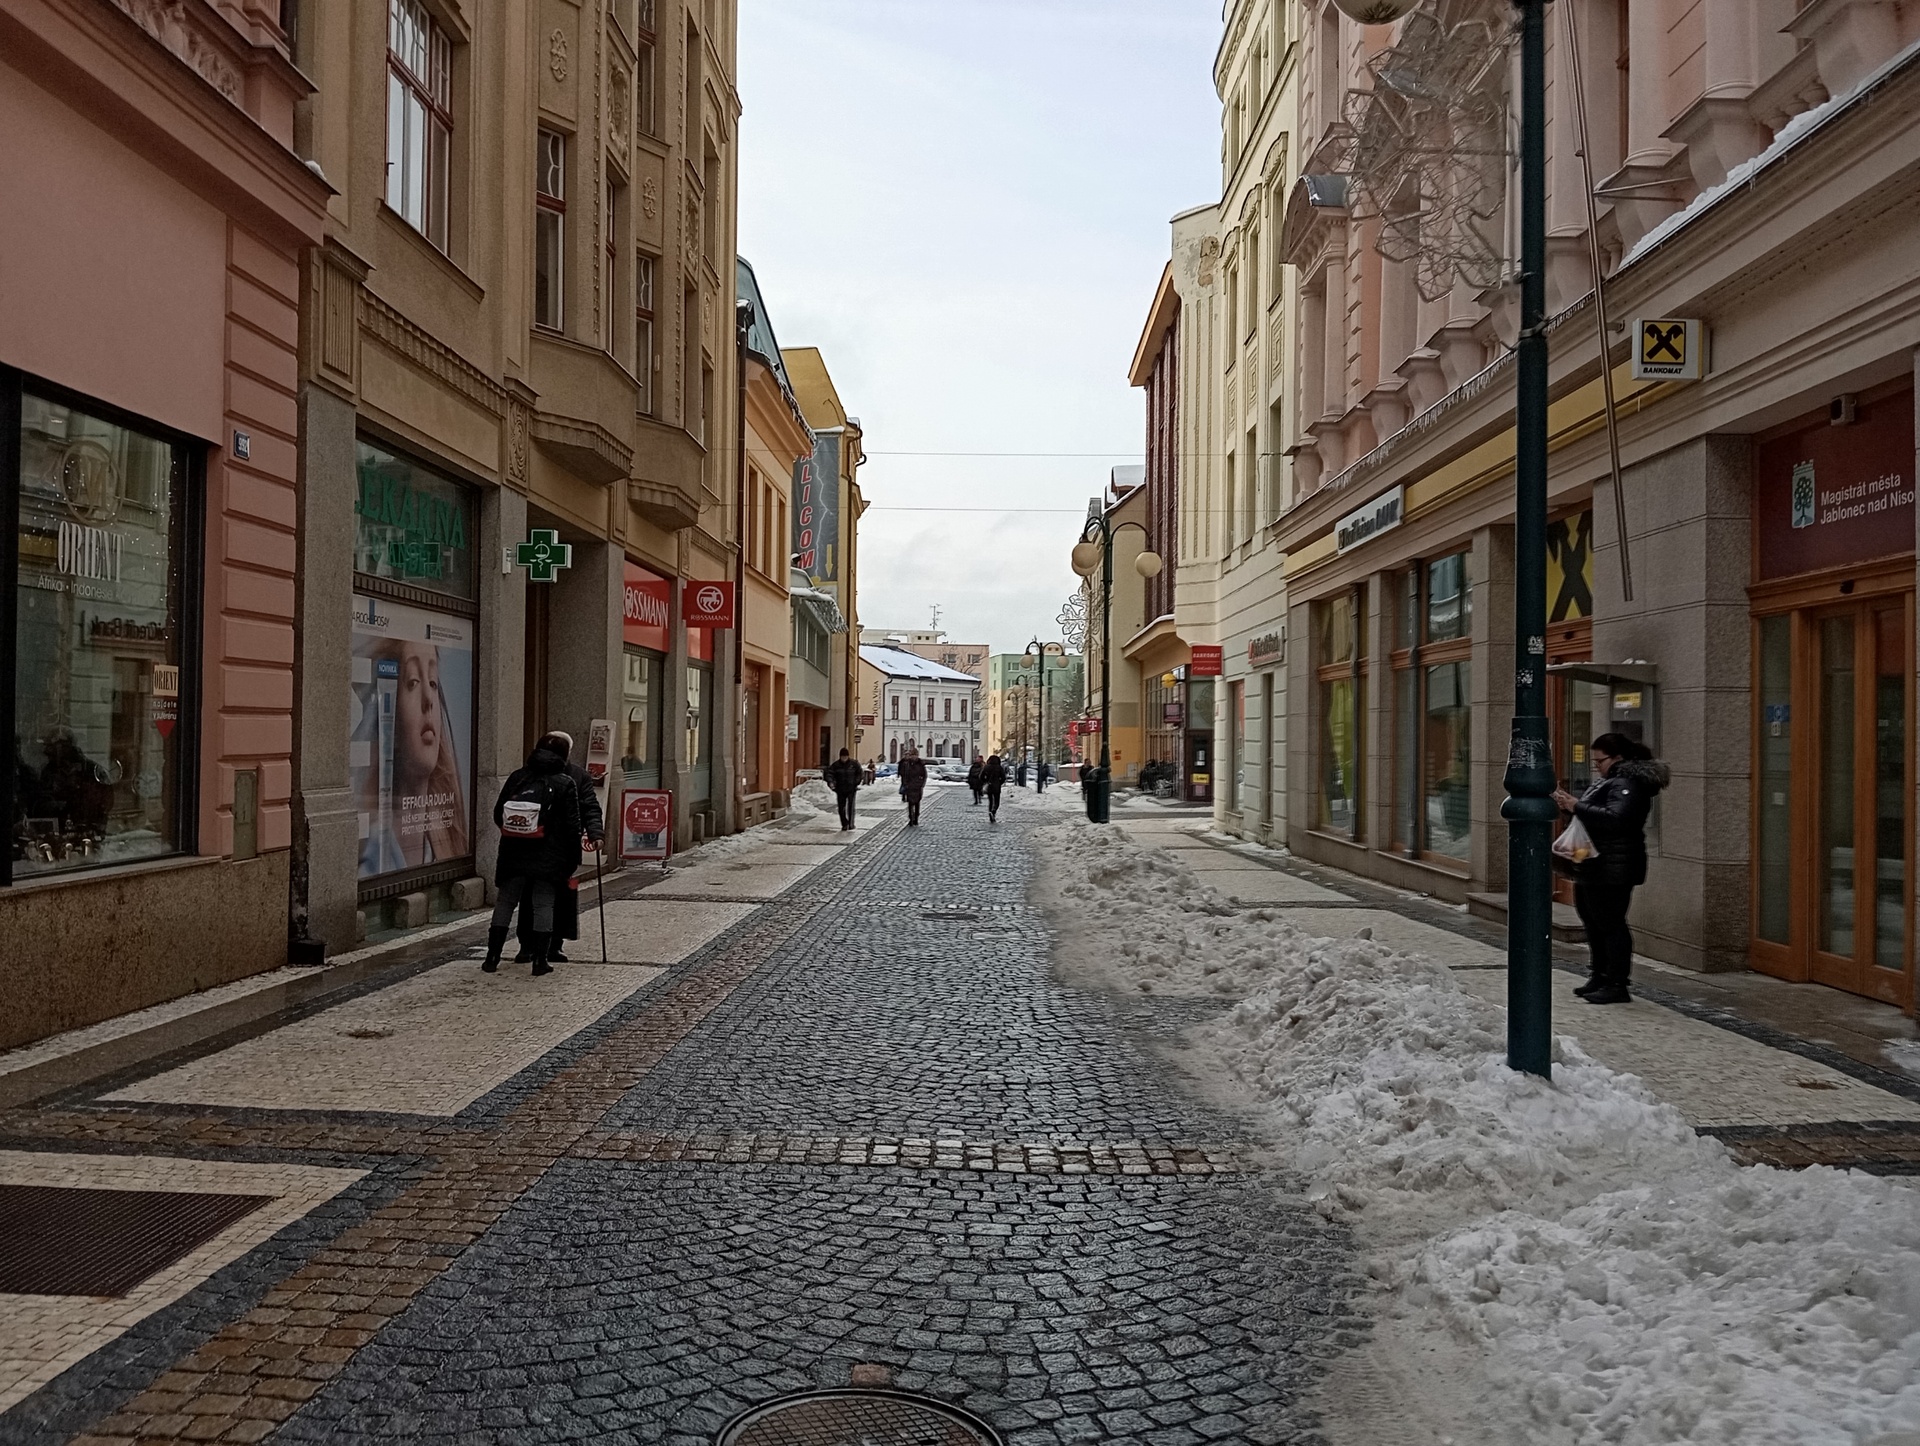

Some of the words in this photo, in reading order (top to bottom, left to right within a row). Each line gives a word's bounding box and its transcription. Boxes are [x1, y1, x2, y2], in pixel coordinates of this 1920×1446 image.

[354, 456, 465, 550] ÉKÁRNA
[1820, 481, 1867, 507] Magistrát
[1869, 473, 1901, 494] města
[1820, 503, 1866, 525] Jablonec
[1867, 494, 1888, 514] nad
[1890, 490, 1915, 510] Niso
[57, 520, 125, 583] ORIENT
[37, 574, 63, 592] Afrika
[690, 614, 730, 622] ROSSMANN
[154, 670, 178, 691] ORIENT
[402, 794, 433, 810] EFFACLAR
